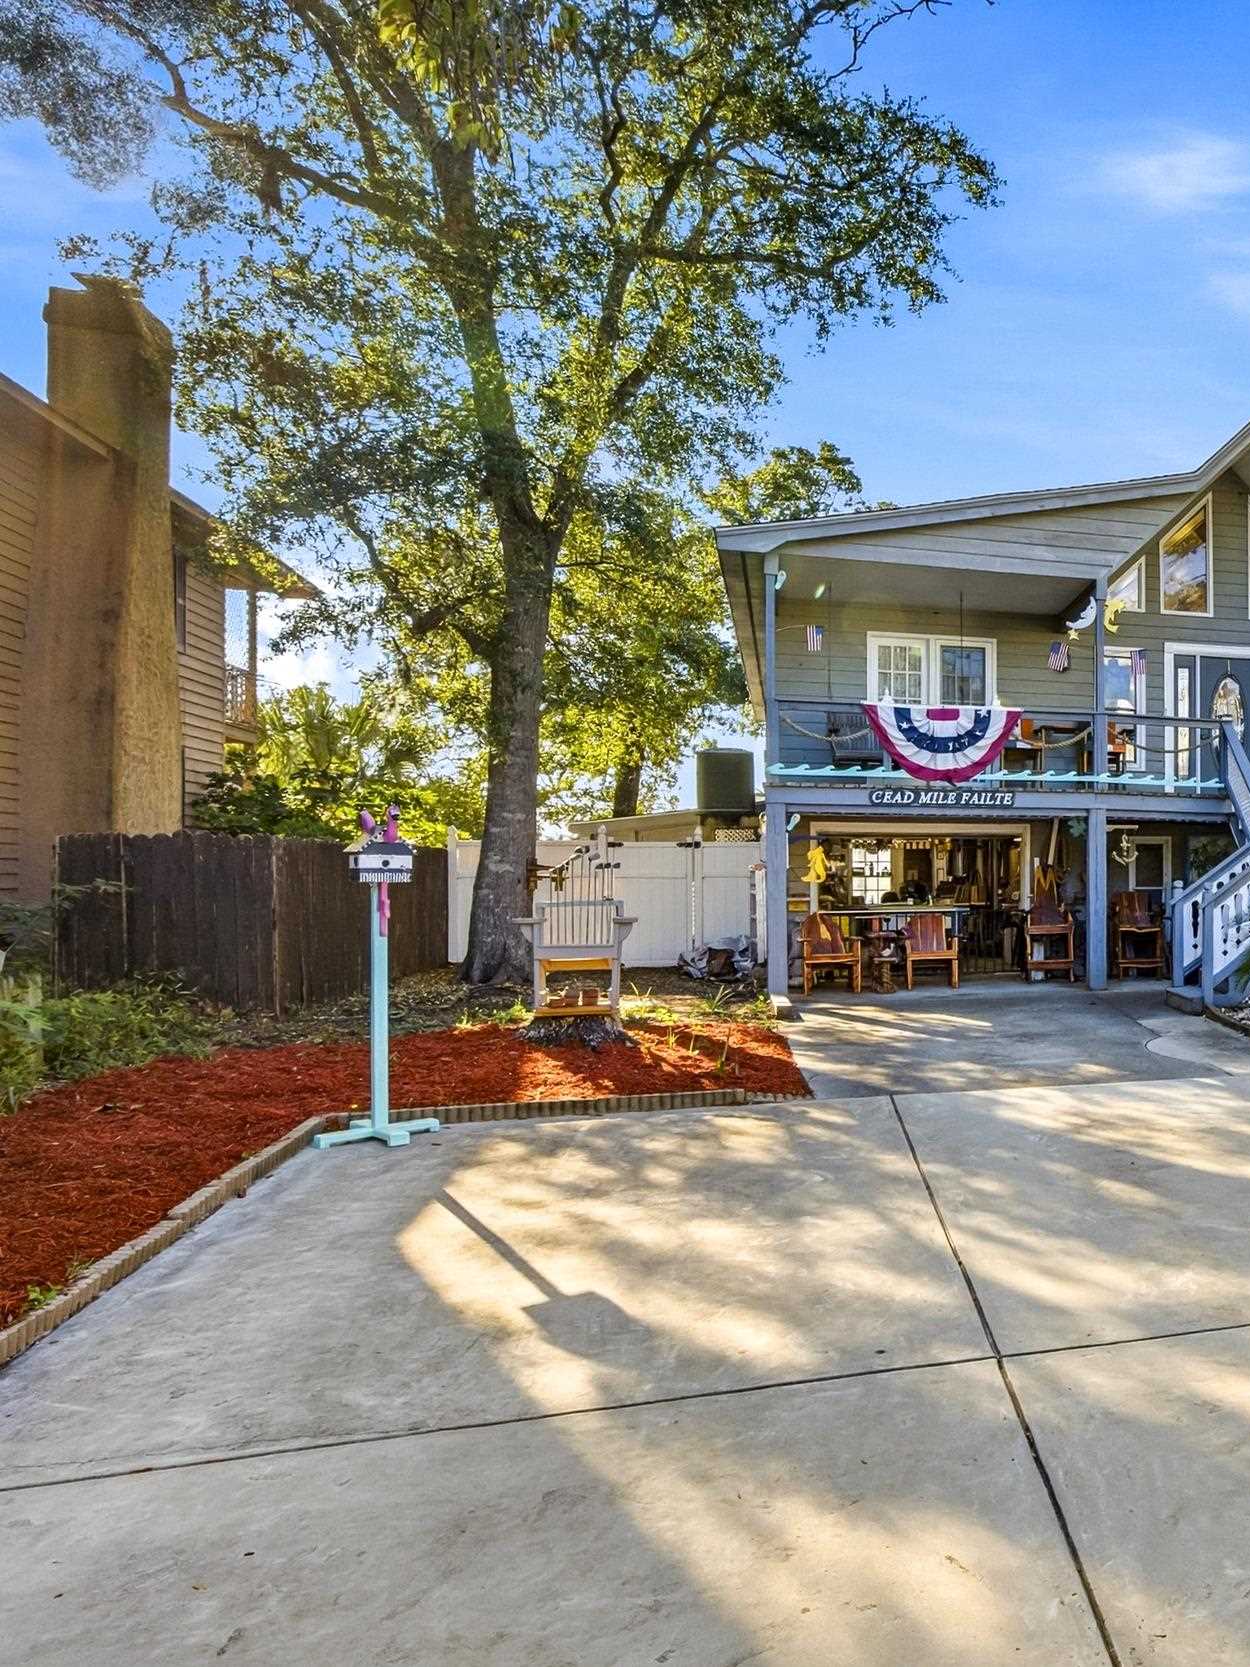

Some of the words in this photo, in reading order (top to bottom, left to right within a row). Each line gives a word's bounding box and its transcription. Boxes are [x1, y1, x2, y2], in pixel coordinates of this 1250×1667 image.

[871, 790, 914, 804] CEAD
[918, 791, 957, 805] MILE
[960, 792, 1013, 805] FAILTE
